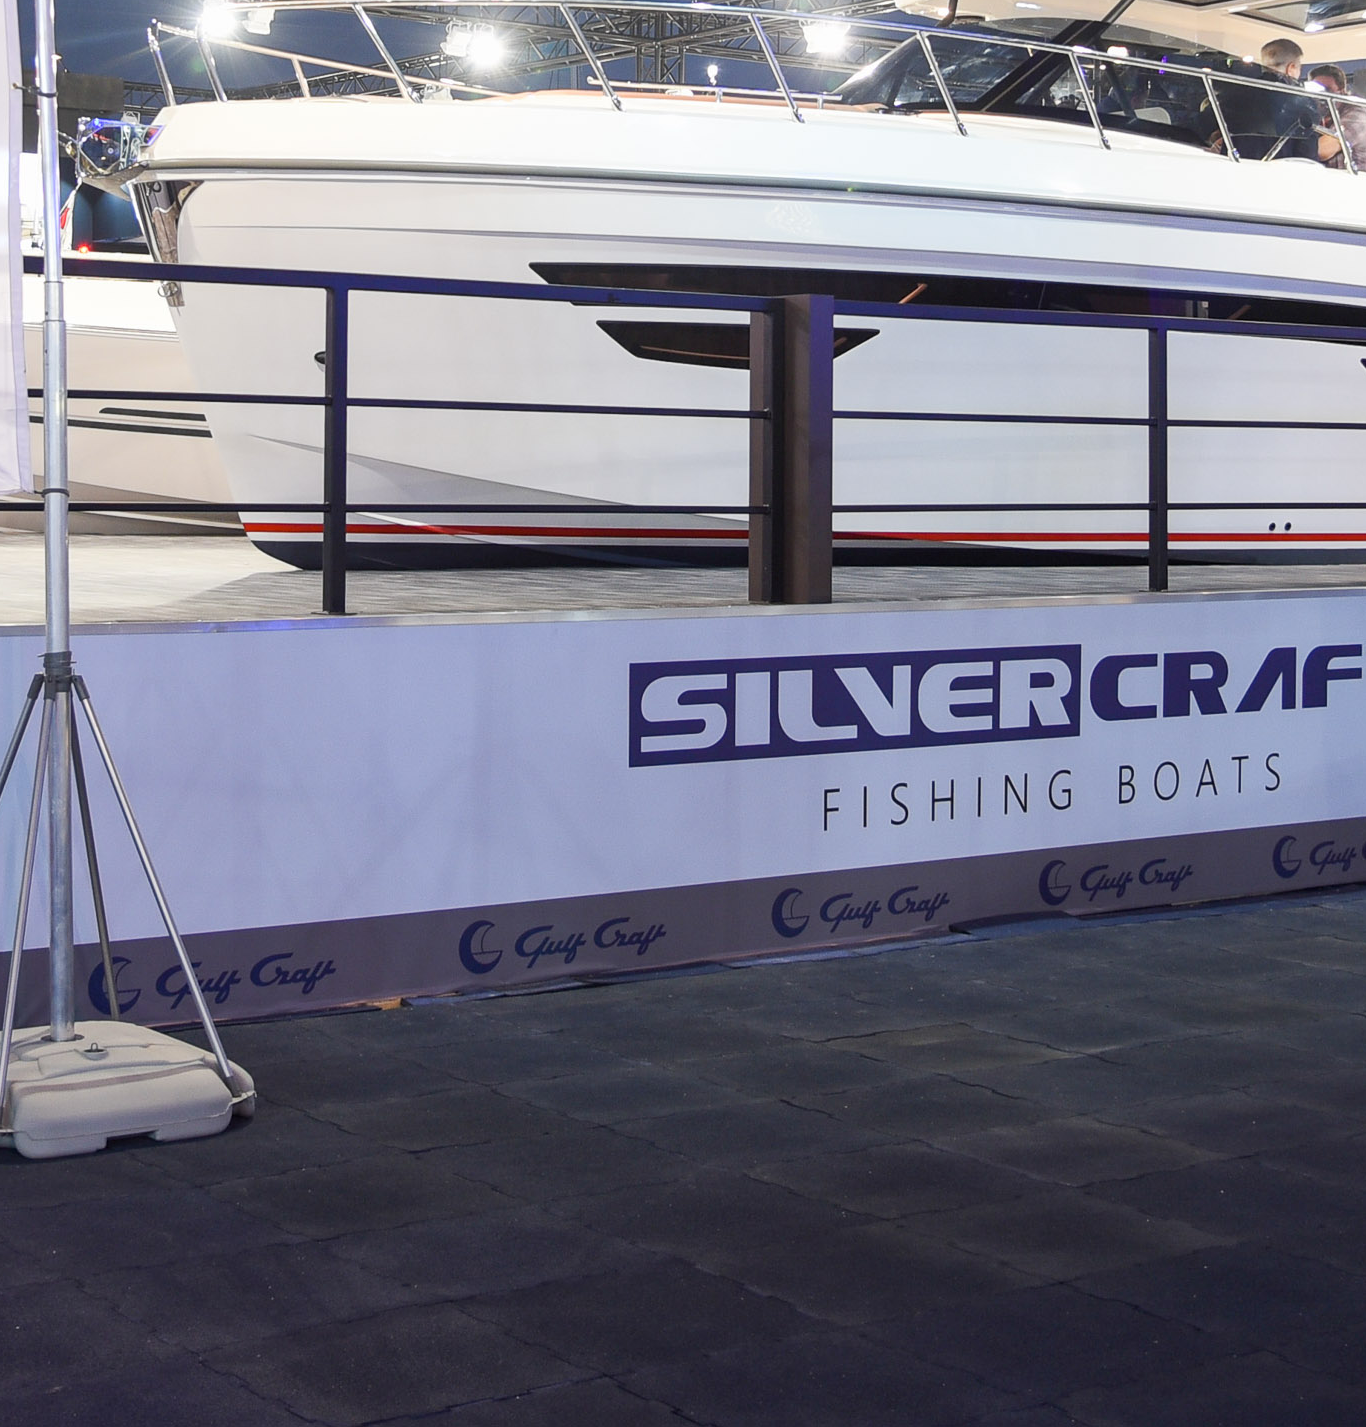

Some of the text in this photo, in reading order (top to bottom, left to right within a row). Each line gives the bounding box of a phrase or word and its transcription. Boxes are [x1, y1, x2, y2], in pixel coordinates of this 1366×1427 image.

[822, 752, 1283, 831] FISHING BOATS
[1080, 858, 1194, 901] Gulf Craft
[1309, 840, 1357, 875] Gulf
[820, 886, 950, 933] Gulf Craft
[514, 917, 667, 968] Gulf Craft
[250, 952, 337, 995] Craft
